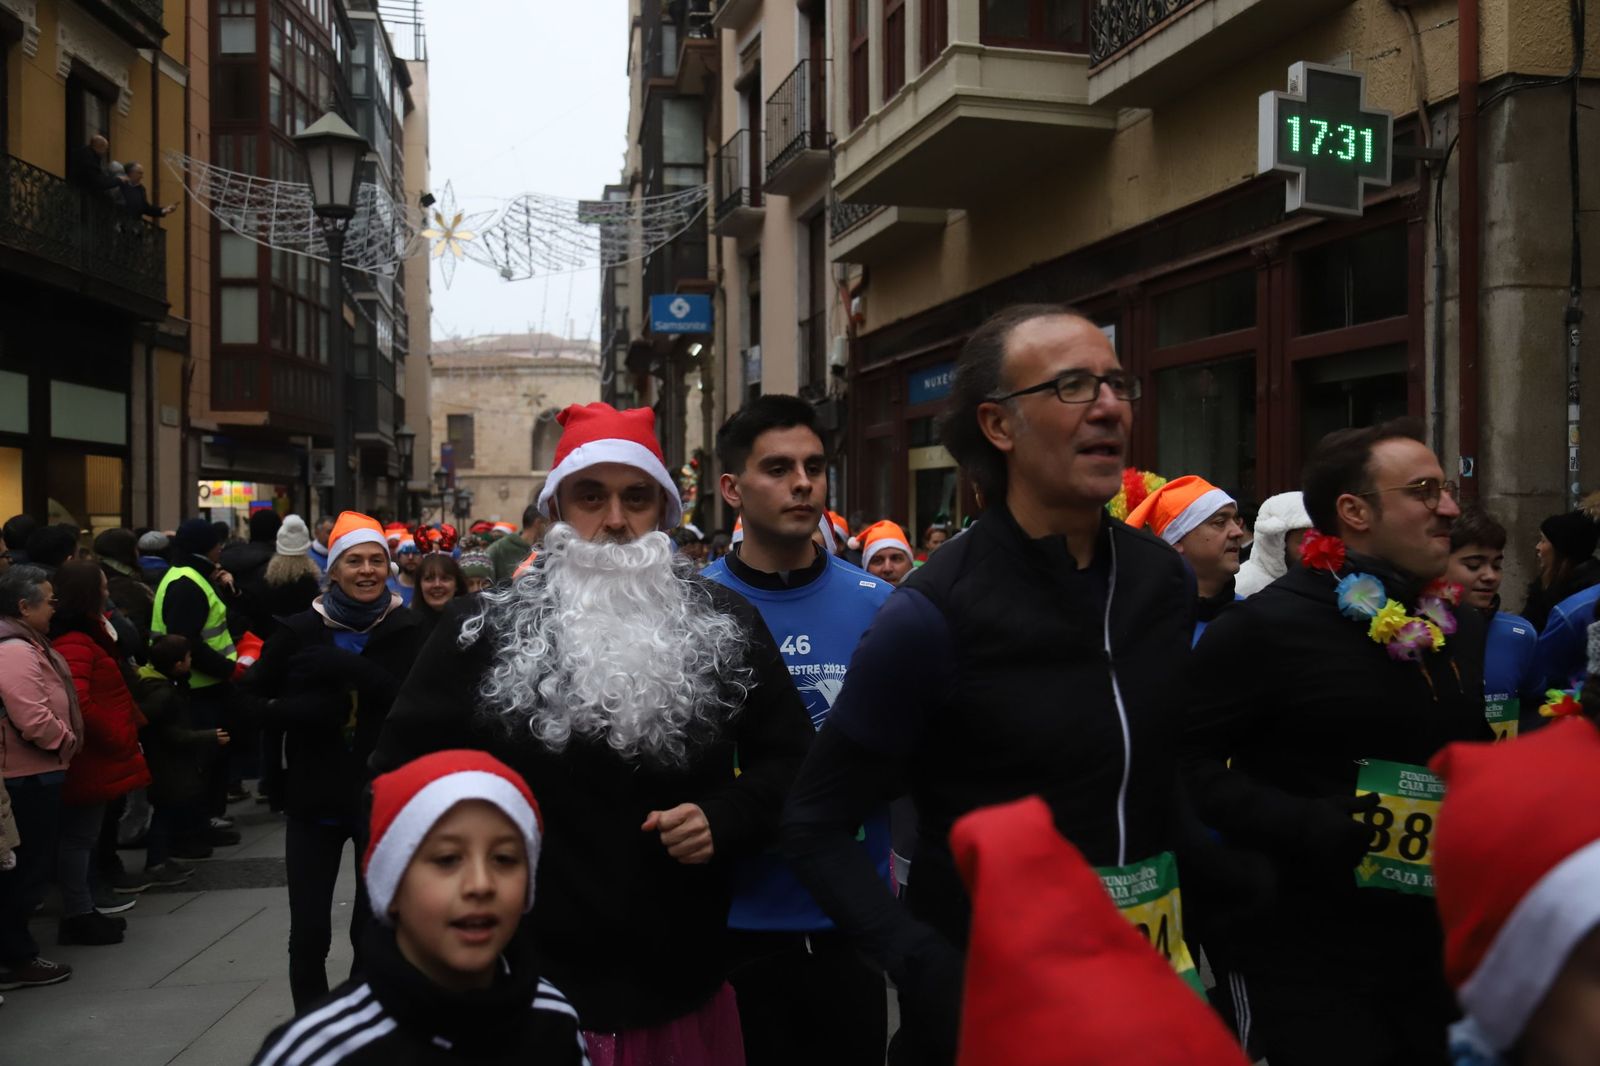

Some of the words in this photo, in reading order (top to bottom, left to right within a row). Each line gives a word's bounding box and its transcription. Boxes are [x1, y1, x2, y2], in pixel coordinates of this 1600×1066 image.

[1287, 116, 1372, 163] 17:31
[655, 321, 707, 331] Samsonite
[780, 634, 811, 655] 46
[785, 663, 820, 676] ESTRE
[823, 662, 848, 674] 2025
[1400, 770, 1441, 783] FUNDAC
[1381, 867, 1419, 885] CAJA
